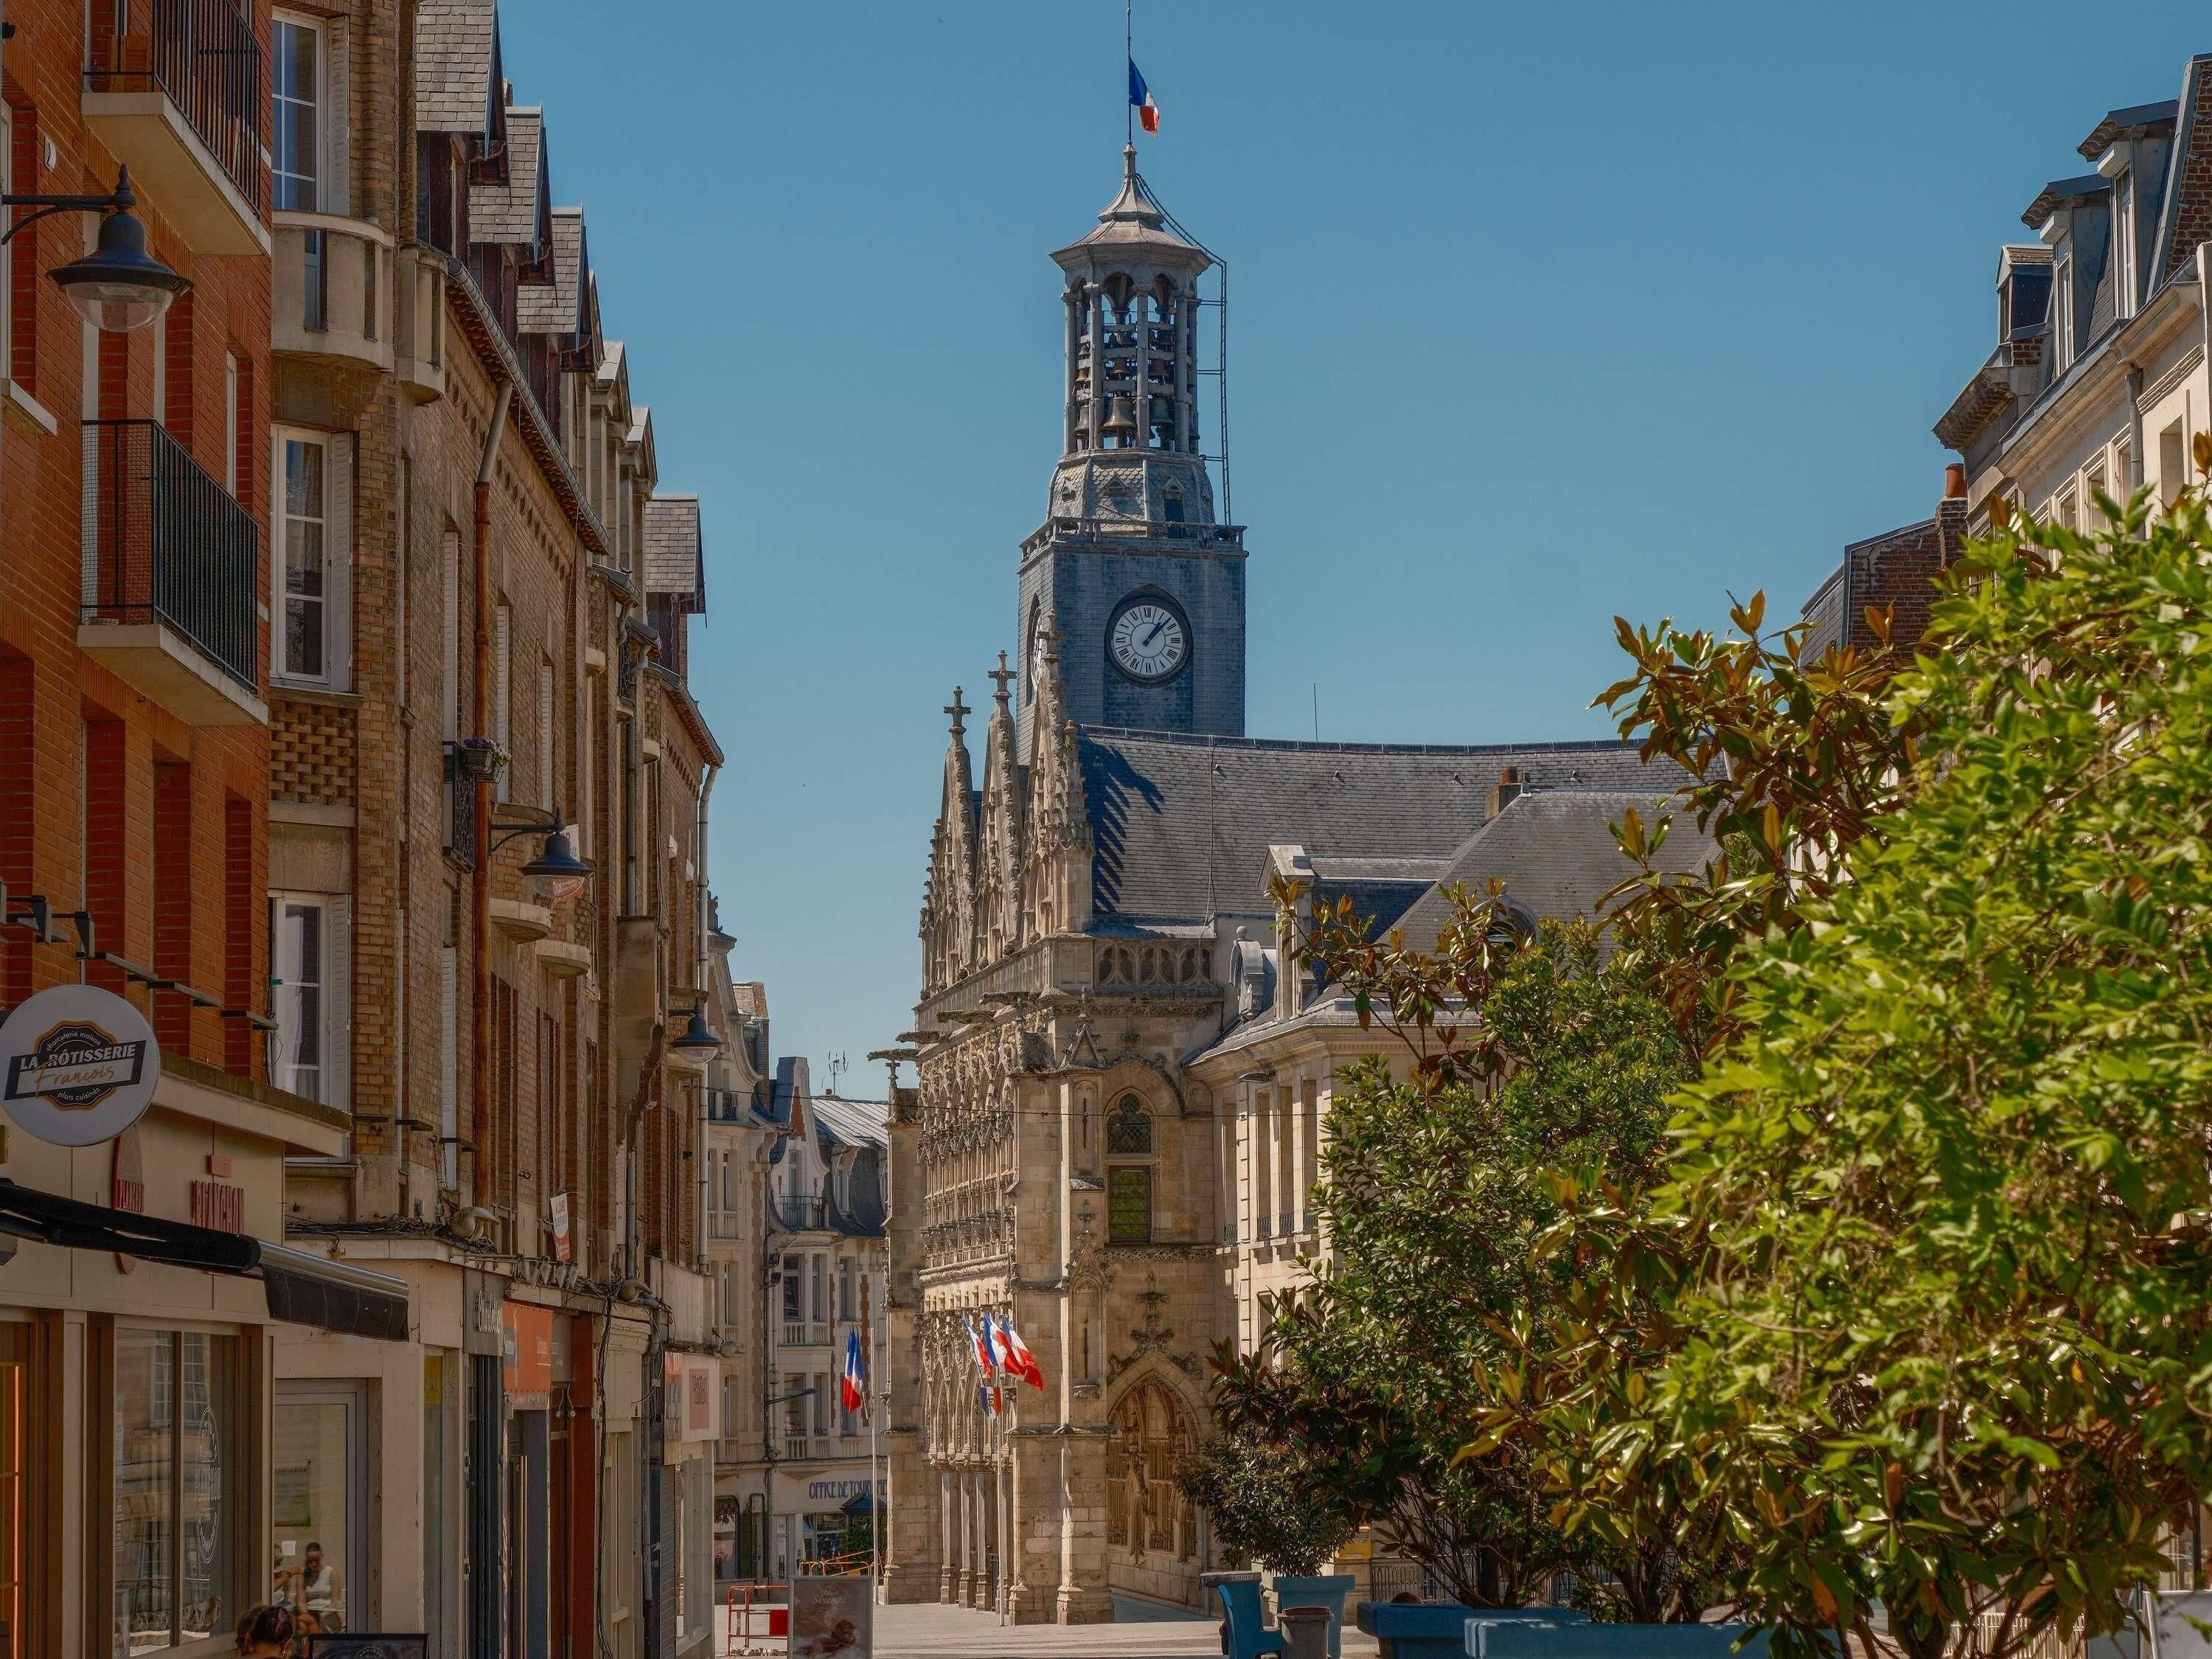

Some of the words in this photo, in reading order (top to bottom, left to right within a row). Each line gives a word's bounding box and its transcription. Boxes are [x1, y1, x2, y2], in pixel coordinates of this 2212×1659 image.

[1130, 611, 1138, 621] XI
[1158, 612, 1164, 621] I
[46, 1031, 78, 1051] charcuterie
[80, 1032, 101, 1046] maison
[20, 1057, 38, 1071] LA
[47, 1043, 136, 1068] RÔTISSERIE
[57, 1091, 74, 1101] plats
[809, 1481, 836, 1499] OFFICE
[838, 1481, 849, 1498] DE
[849, 1479, 888, 1498] TOURIME
